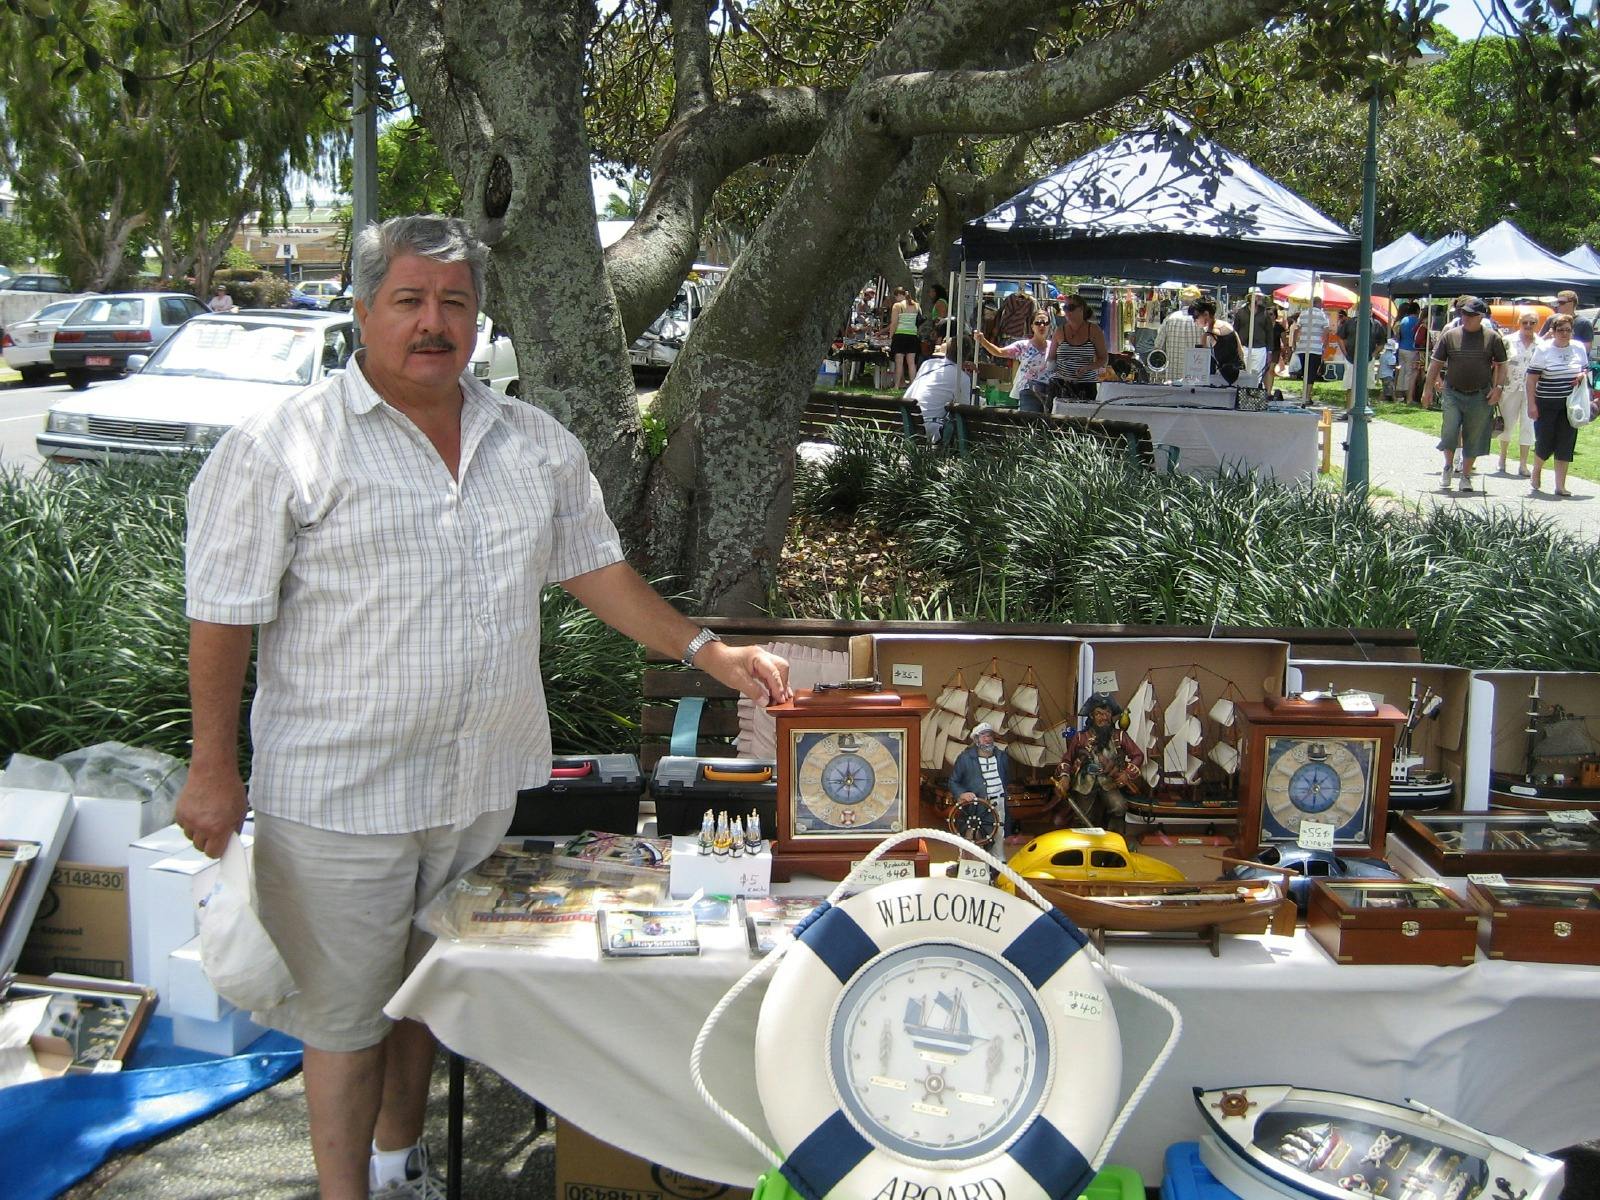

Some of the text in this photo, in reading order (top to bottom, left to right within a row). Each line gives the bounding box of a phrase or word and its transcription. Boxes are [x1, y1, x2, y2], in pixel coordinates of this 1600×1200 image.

[52, 870, 121, 888] 2148430
[740, 873, 760, 887] $5
[965, 866, 987, 878] $20
[876, 892, 1005, 933] WELCOME
